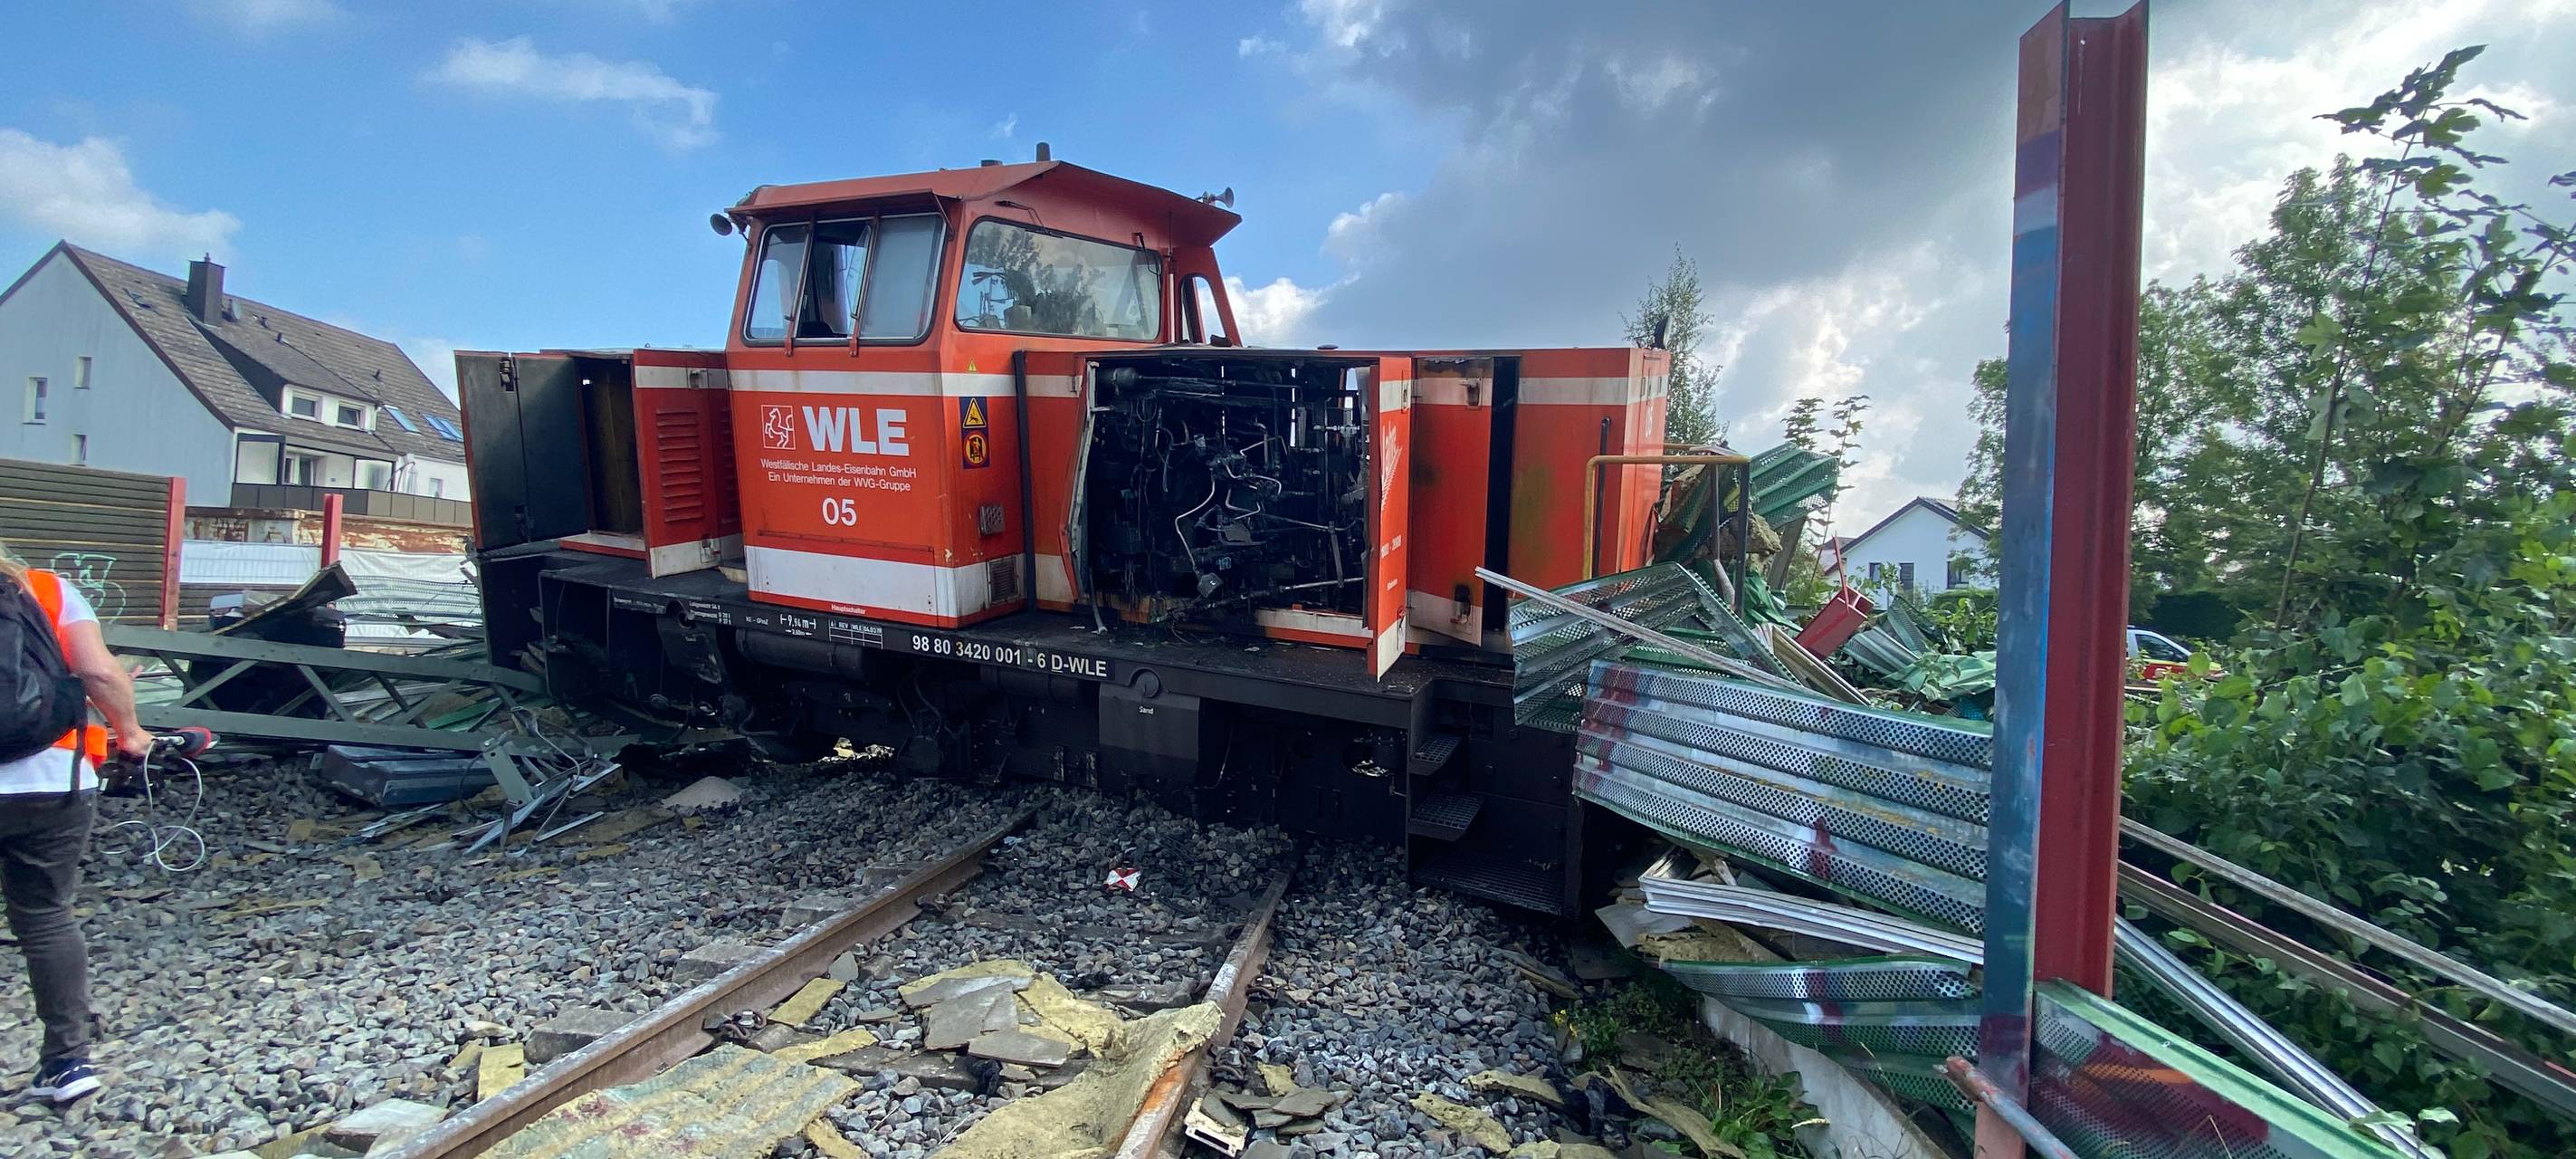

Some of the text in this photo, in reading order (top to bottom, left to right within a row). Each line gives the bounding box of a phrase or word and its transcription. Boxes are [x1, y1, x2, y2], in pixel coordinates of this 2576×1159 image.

[802, 406, 910, 456] WLE
[760, 458, 917, 479] Westfälische Landes-Eisenbahn GmbH
[768, 472, 911, 493] Ein Unternehmen der WVG-Gruppe
[822, 497, 857, 526] 05
[912, 635, 930, 652] 98
[934, 638, 950, 655] 80
[956, 641, 991, 660] 3420
[996, 647, 1021, 666] 001
[1036, 652, 1046, 668] 6
[1051, 654, 1108, 677] D-WLE
[1139, 705, 1154, 715] Sand
